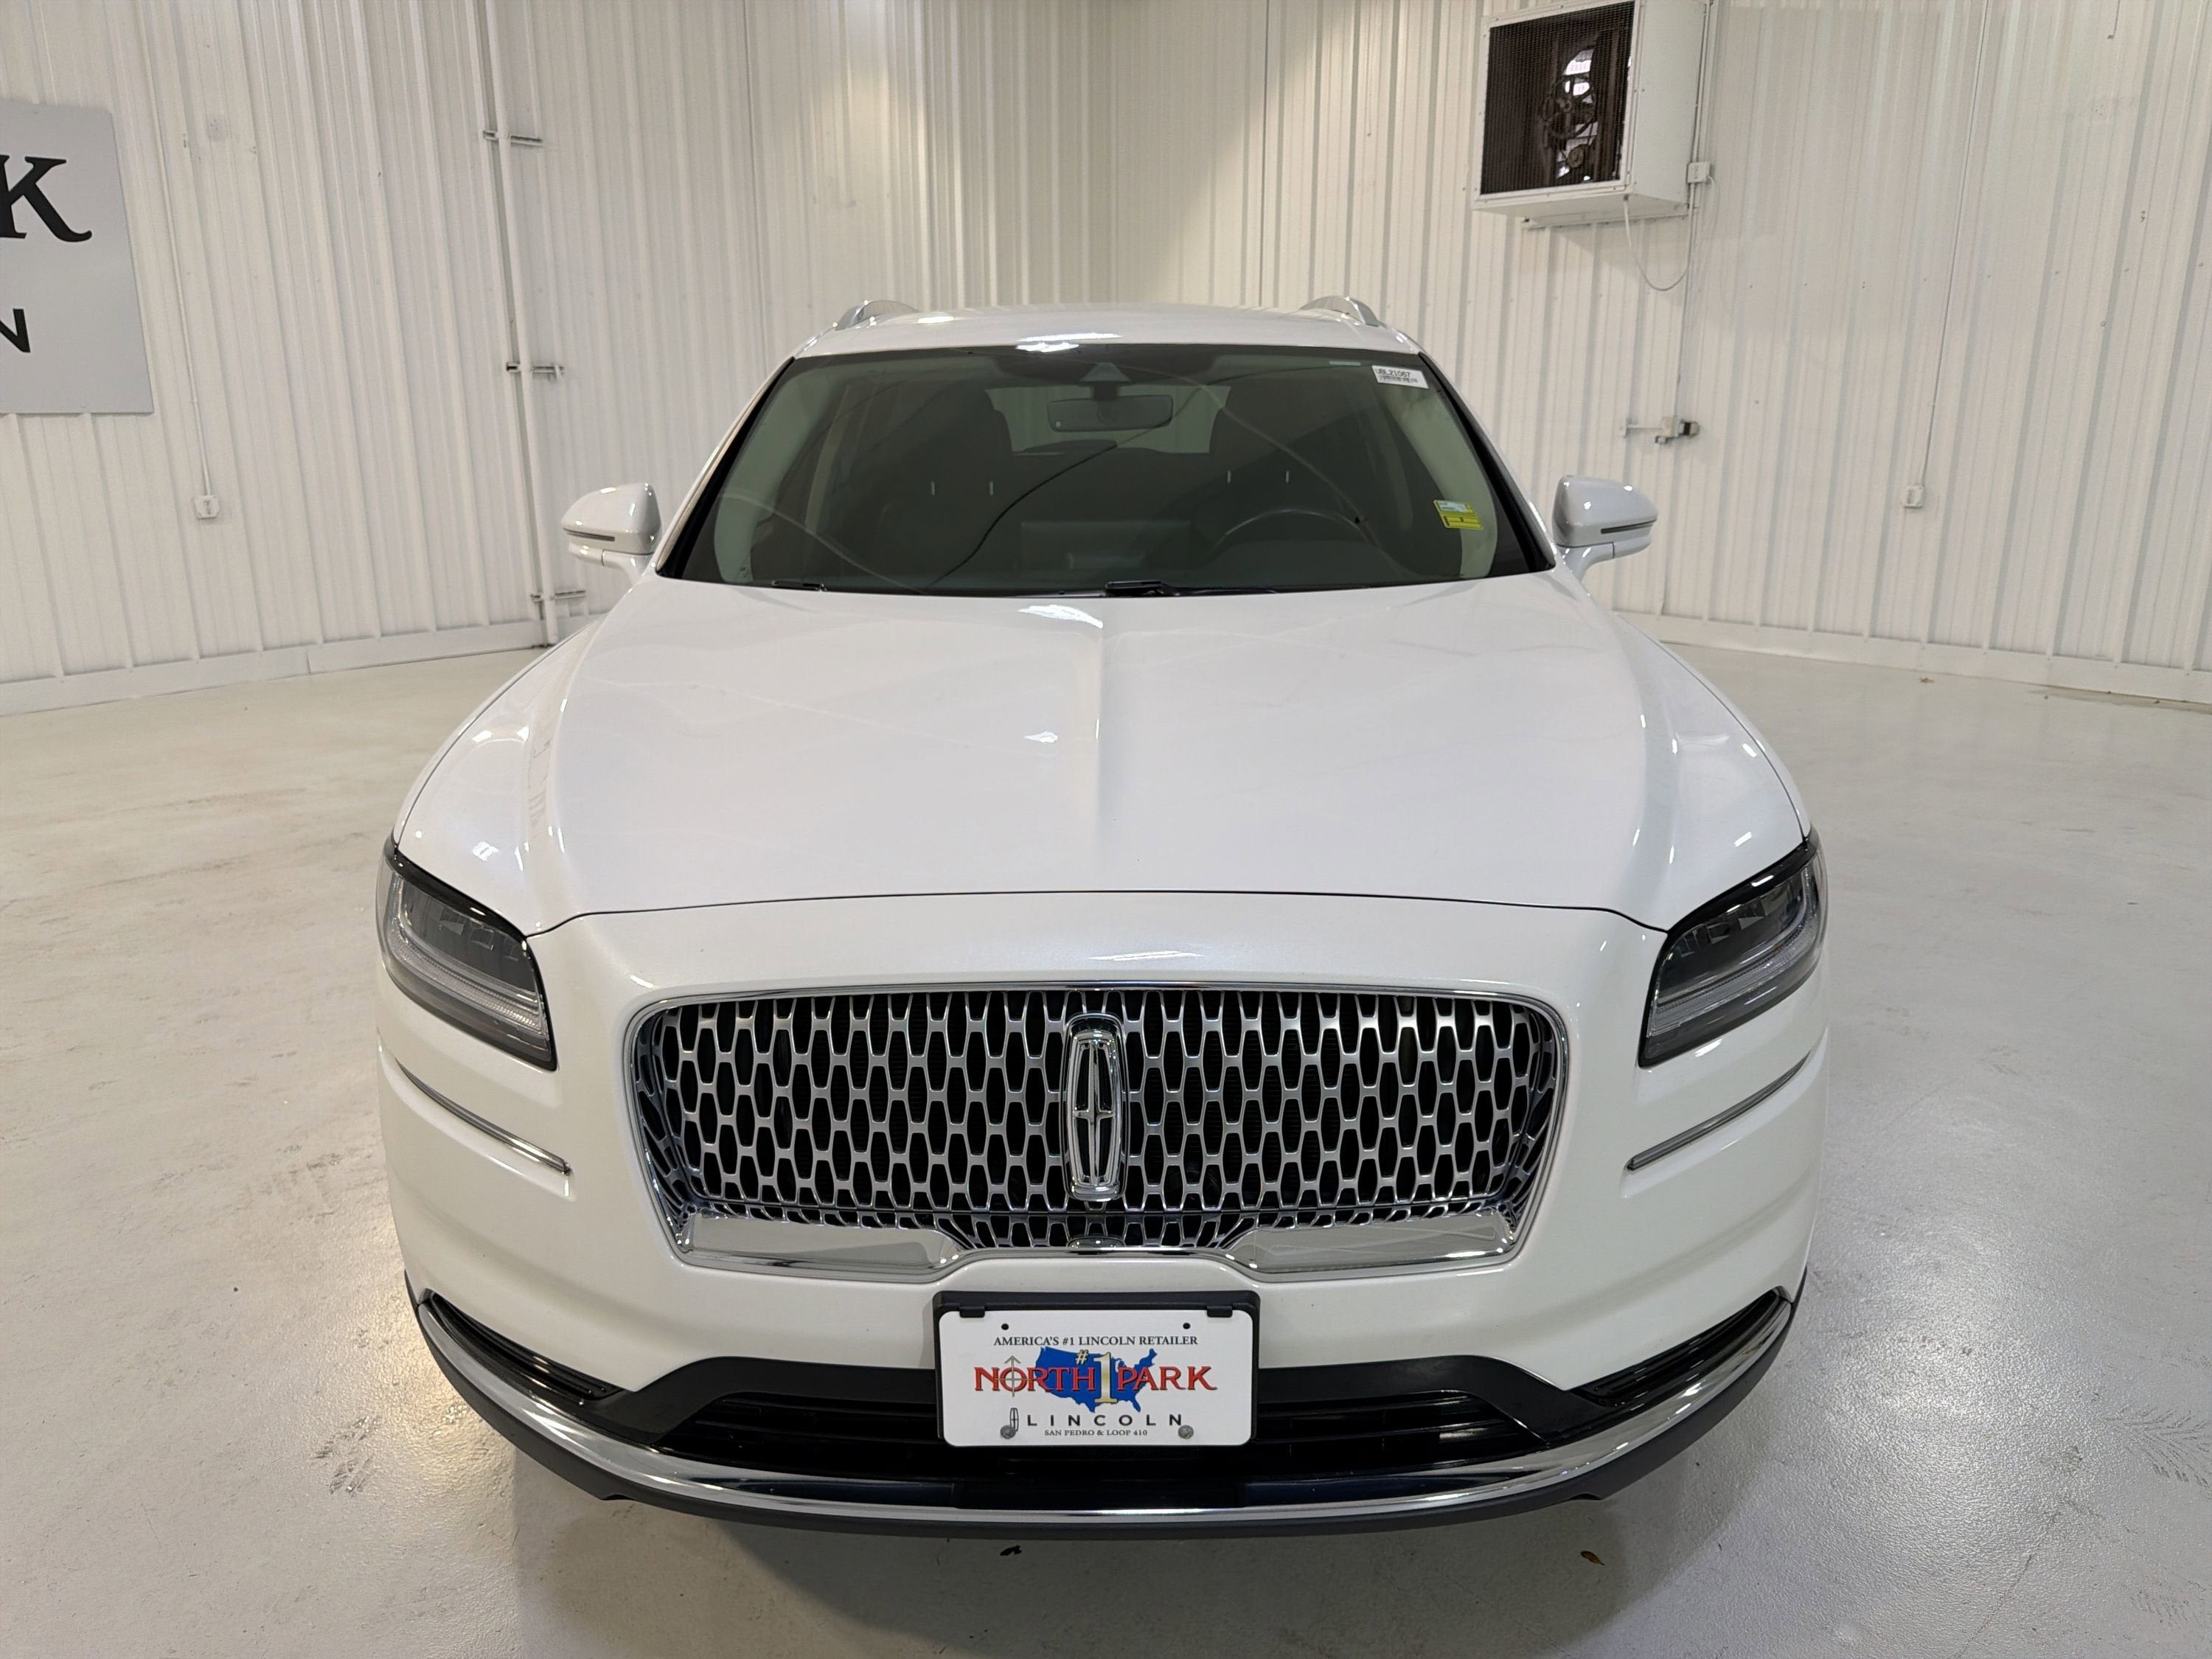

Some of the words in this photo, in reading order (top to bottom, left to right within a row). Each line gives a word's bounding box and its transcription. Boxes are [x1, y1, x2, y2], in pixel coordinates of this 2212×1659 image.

[993, 1336, 1060, 1346] AMERICA'S
[1062, 1336, 1074, 1346] #1
[1078, 1335, 1135, 1346] LINCOLN
[1138, 1335, 1198, 1345] RETAILER
[973, 1366, 1096, 1392] NORTH
[1116, 1365, 1218, 1391] PARK
[1026, 1413, 1182, 1427] LINCOLN
[1133, 1428, 1148, 1436] 410
